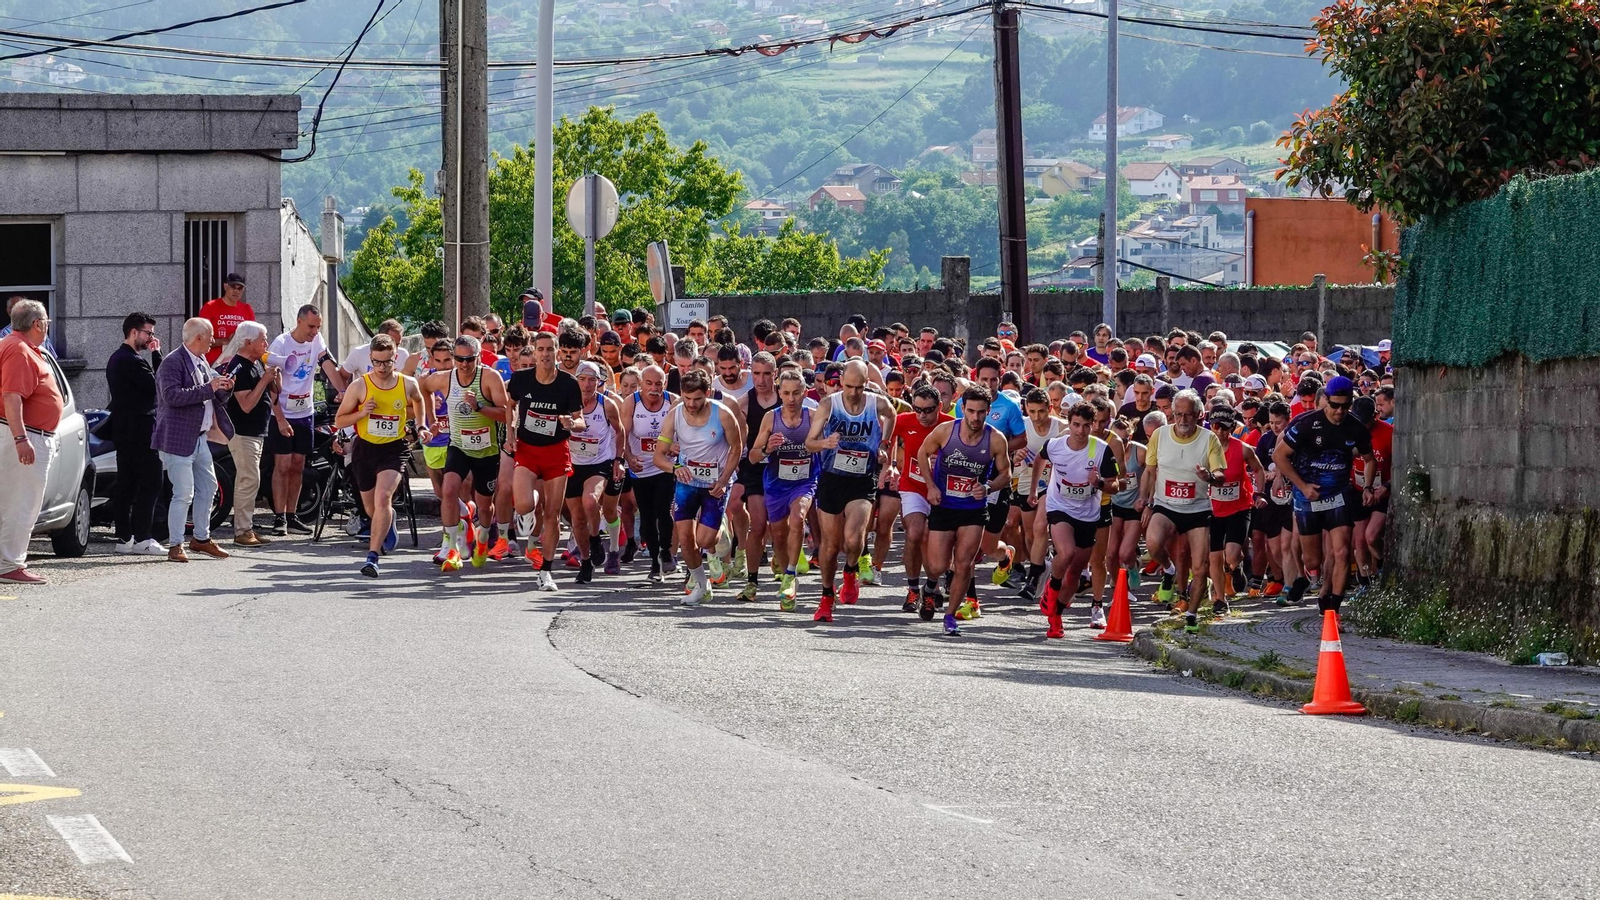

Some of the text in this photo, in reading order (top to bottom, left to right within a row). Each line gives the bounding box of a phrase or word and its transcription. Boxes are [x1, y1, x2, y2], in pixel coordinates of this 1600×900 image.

[530, 401, 558, 410] BIKILA
[375, 421, 394, 431] 163
[534, 419, 547, 428] 58
[838, 421, 873, 436] ADN
[471, 435, 482, 444] 59
[580, 443, 587, 451] 3
[846, 456, 859, 467] 75
[692, 468, 712, 477] 128
[792, 466, 799, 474] 6
[1066, 487, 1085, 495] 159
[1170, 487, 1190, 498] 303
[1217, 488, 1234, 496] 182
